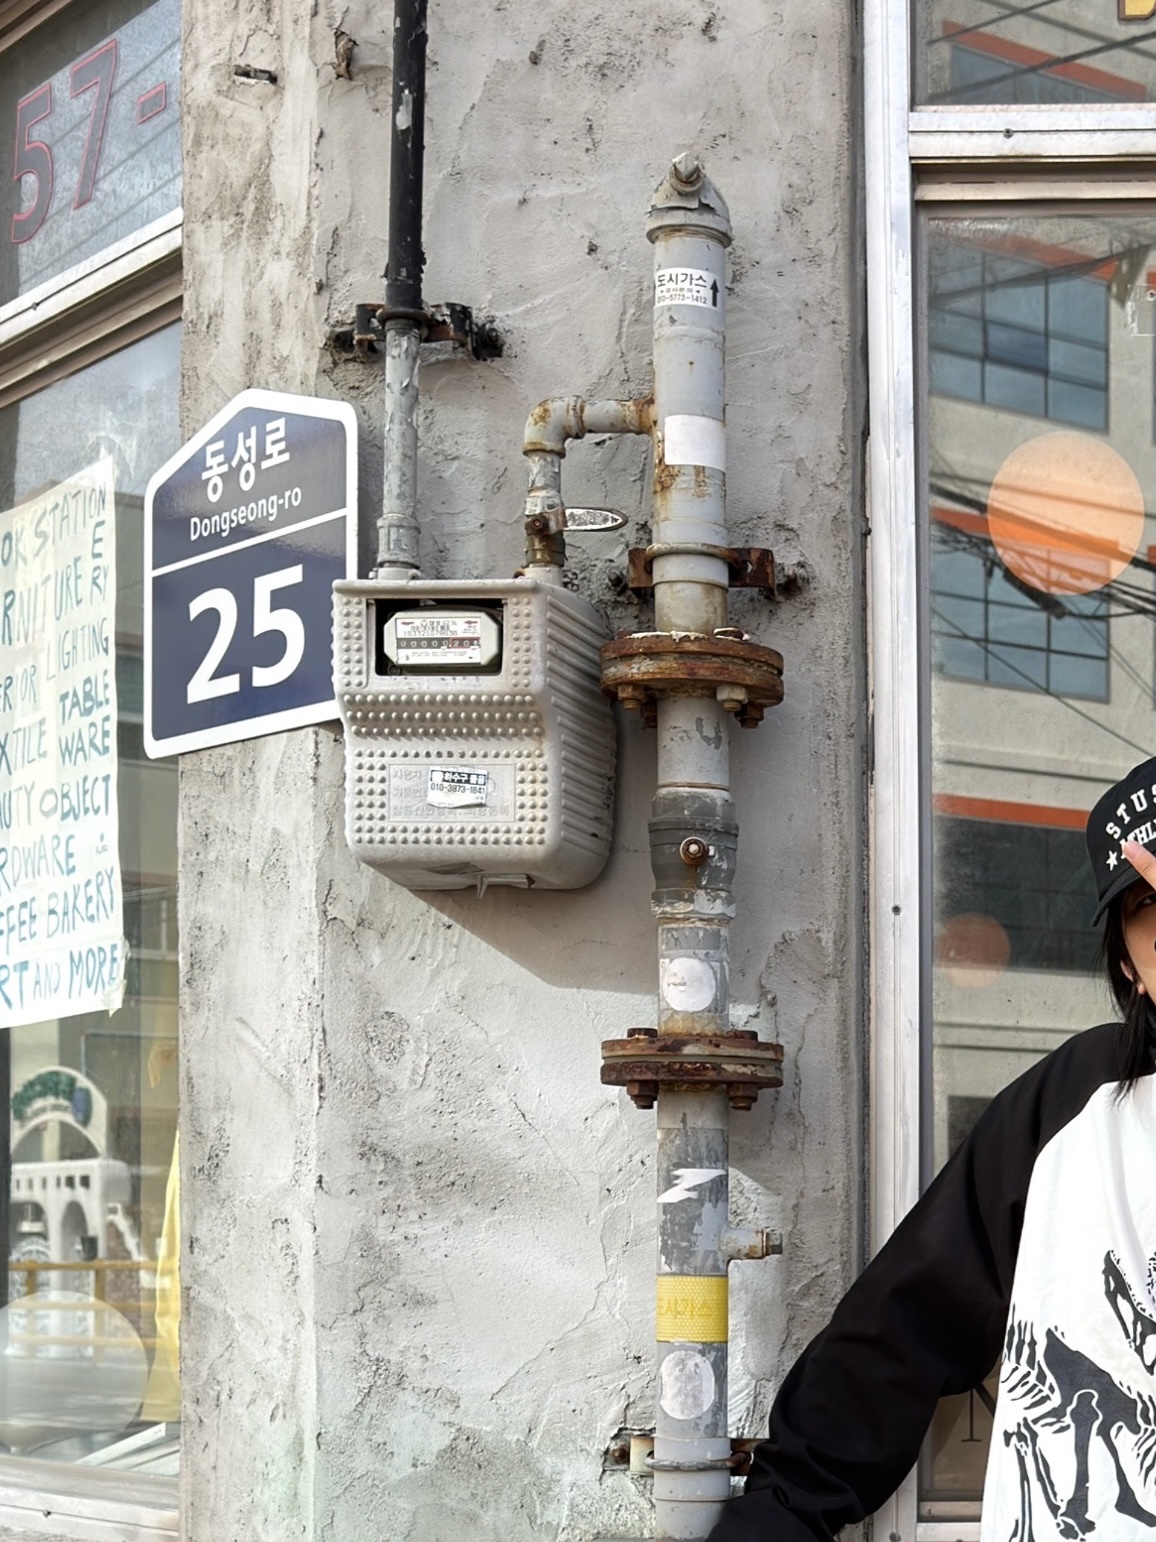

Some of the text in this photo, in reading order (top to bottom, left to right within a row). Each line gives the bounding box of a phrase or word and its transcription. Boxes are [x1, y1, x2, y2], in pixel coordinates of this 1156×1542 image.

[657, 272, 707, 288] 도시가스
[202, 417, 291, 503] 동성로
[33, 482, 107, 558] STATION
[190, 487, 302, 541] Dongseong-ro
[46, 617, 109, 681] LIGHTING
[187, 564, 305, 704] 25
[59, 669, 110, 726] TABLE
[59, 715, 110, 766] WARE
[39, 774, 111, 821] OBJECT
[47, 866, 114, 938] BAKERY
[33, 962, 60, 1000] AND
[69, 944, 118, 999] MORE
